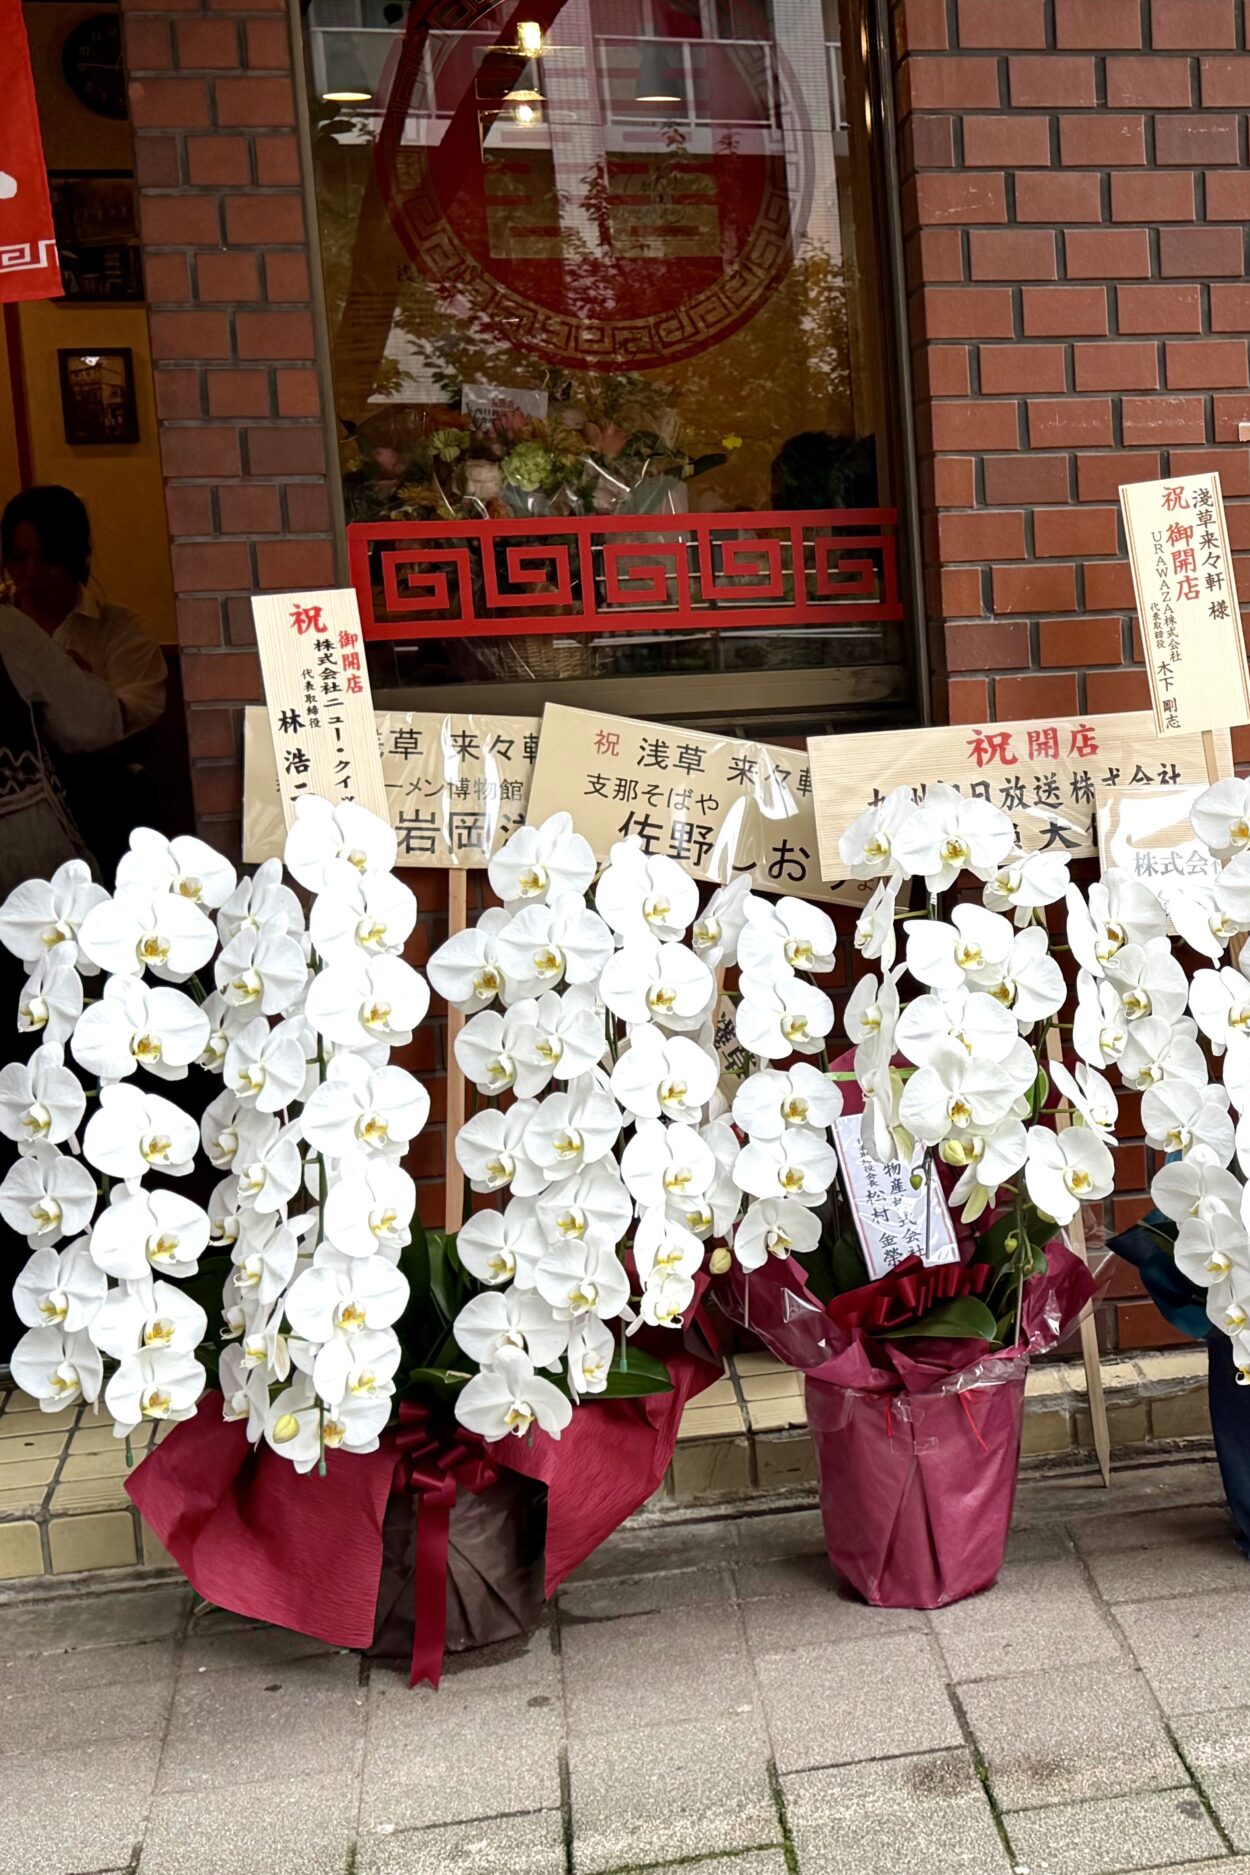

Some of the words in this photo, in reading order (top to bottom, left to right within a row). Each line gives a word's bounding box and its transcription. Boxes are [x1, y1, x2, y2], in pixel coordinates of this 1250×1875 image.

[1160, 485, 1191, 513] 祝
[1165, 523, 1201, 602] 御開店
[289, 603, 329, 635] 祝
[338, 630, 364, 694] 御開店
[1156, 660, 1176, 692] 木下
[277, 708, 306, 734] 林
[301, 668, 322, 729] 代表取締役
[1162, 697, 1181, 729] 剛志
[592, 728, 621, 757] 祝
[636, 736, 707, 777] 浅草
[965, 723, 1101, 768] 祝開店
[583, 772, 720, 817] 支那そばや
